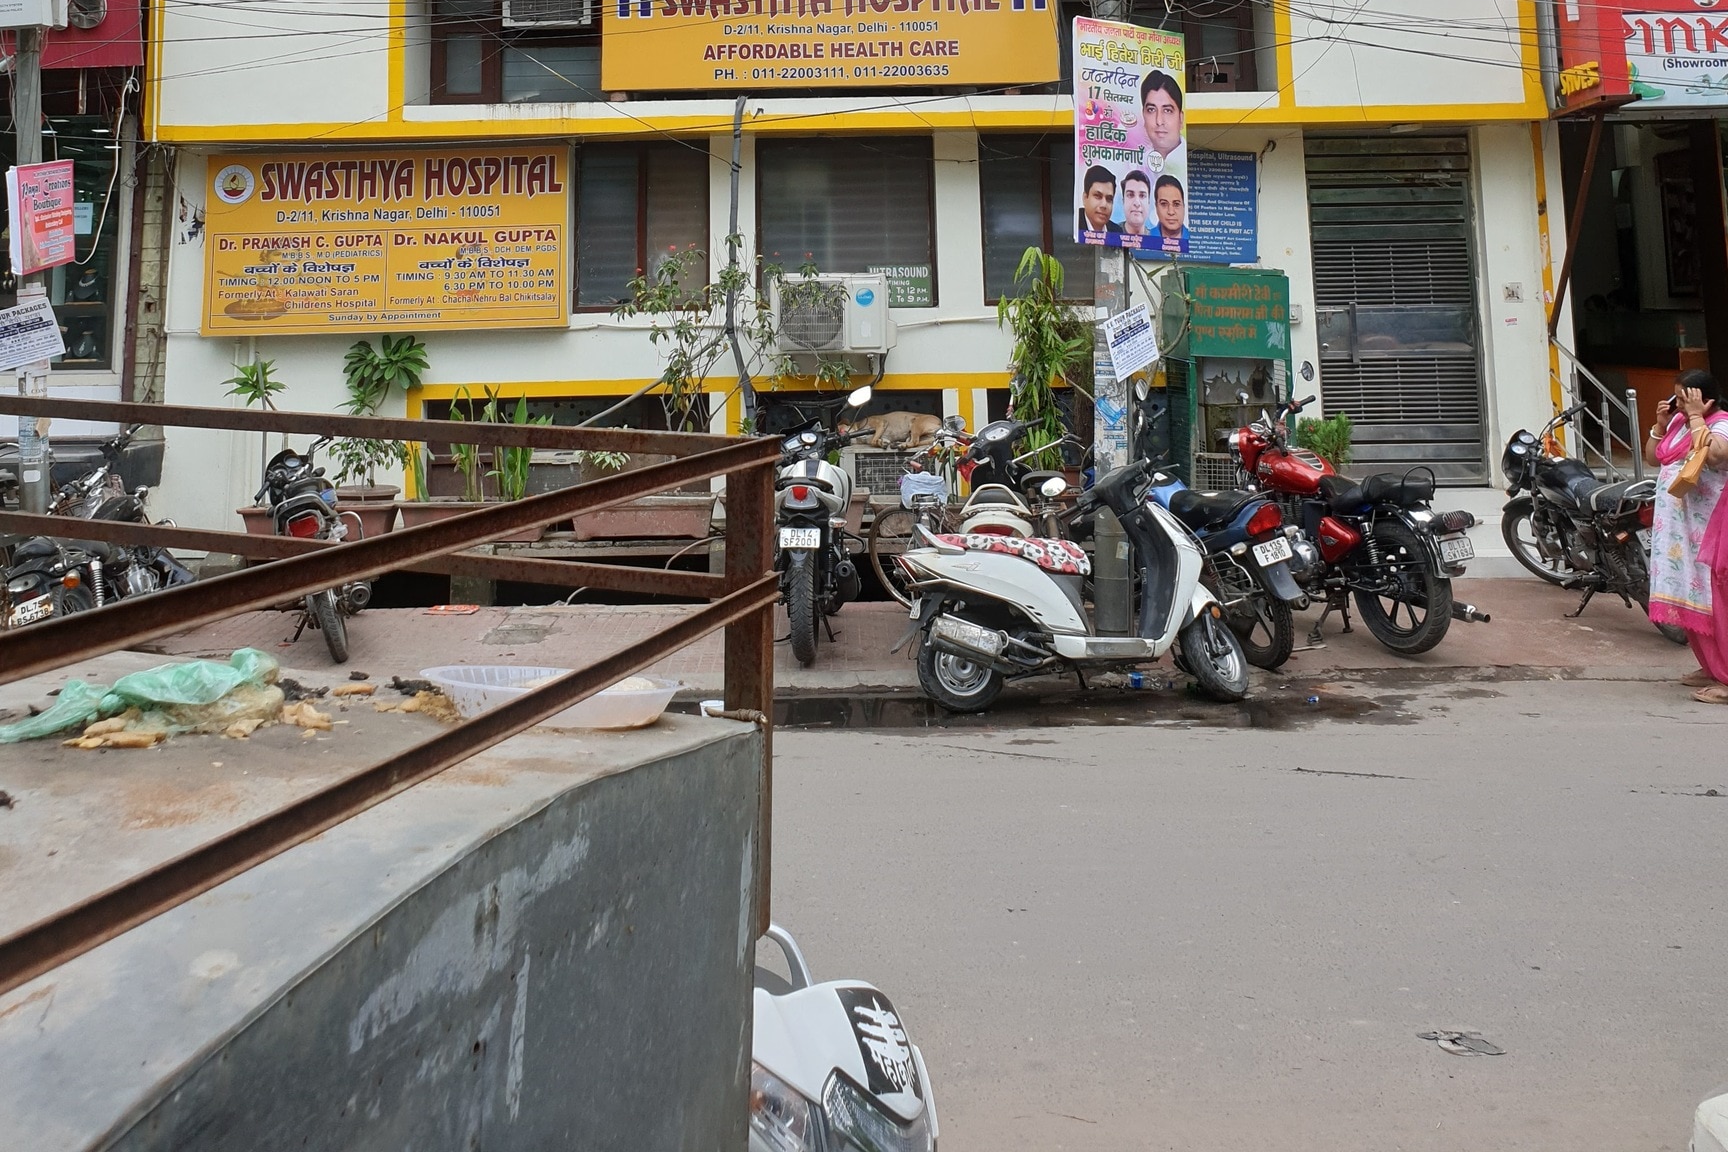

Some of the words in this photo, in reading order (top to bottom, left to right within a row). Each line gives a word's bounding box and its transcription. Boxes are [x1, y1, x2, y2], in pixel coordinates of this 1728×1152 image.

[724, 24, 763, 36] D-2/11,
[767, 24, 813, 35] Krishna
[816, 23, 854, 36] Nagar,
[858, 22, 888, 33] Delhi
[899, 21, 939, 32] 110051
[703, 43, 824, 61] AFFORDABLE
[830, 41, 903, 58] HEALTH
[909, 40, 960, 57] CARE
[1080, 39, 1104, 61] भाई
[1166, 51, 1183, 71] जी
[714, 69, 739, 80] PH.
[752, 65, 849, 80] 011-22003111,
[854, 64, 949, 78] 011-22003635
[1082, 67, 1140, 88] जन्मदिन
[1088, 86, 1101, 100] 17
[1103, 89, 1134, 104] सितम्बर
[1085, 122, 1127, 142] हार्दिक
[1218, 152, 1253, 161] Ultrasound
[260, 159, 415, 205] SWASTHYA
[424, 155, 563, 202] HOSPITAL
[277, 210, 318, 224] D-2/11,
[322, 209, 369, 222] Krishna
[373, 208, 413, 223] Nagar,
[416, 206, 448, 219] Delhi
[459, 205, 501, 218] 110051
[219, 239, 237, 251] Dr.
[242, 236, 311, 250] PRAKASH
[315, 236, 330, 248] C.
[334, 234, 383, 248] GUPTA
[393, 234, 417, 246] Dr.
[424, 231, 488, 245] NAKUL
[494, 229, 557, 243] GUPTA
[332, 250, 383, 259] (PEDIATRICS)
[244, 262, 280, 274] बच्चों
[283, 263, 297, 273] के
[303, 261, 355, 274] विशेषज्ञ
[419, 257, 455, 269] बच्चों
[457, 258, 471, 269] के
[478, 256, 530, 269] विशेषज्ञ
[218, 278, 257, 286] TIMING
[268, 277, 295, 286] 12.00
[300, 276, 332, 285] NOON
[336, 275, 351, 284] TO
[354, 275, 360, 283] 5
[363, 274, 380, 283] PM
[396, 272, 434, 281] TIMING
[444, 271, 466, 280] 9.30
[469, 270, 486, 279] AM
[490, 270, 504, 278] TO
[507, 269, 535, 278] 11.30
[537, 268, 555, 277] AM
[444, 282, 466, 291] 6.30
[469, 281, 486, 290] PM
[489, 281, 504, 289] TO
[507, 280, 535, 289] 10.00
[538, 279, 554, 288] PM
[218, 290, 262, 301] Formerly
[265, 290, 276, 298] At
[285, 288, 327, 298] Kalawati
[330, 288, 359, 296] Saran
[390, 296, 424, 306] Formerly
[426, 295, 436, 304] At
[442, 294, 472, 304] Chacha
[473, 293, 497, 303] Nehru
[499, 293, 511, 302] Bal
[514, 292, 556, 302] Chikitsalay
[907, 295, 915, 303] 9
[12, 303, 47, 317] PACKAGES
[283, 300, 332, 310] Childrens
[335, 298, 376, 310] Hospital
[328, 314, 364, 323] Sunday
[366, 313, 377, 322] by
[380, 311, 441, 322] Appointment
[784, 538, 817, 546] SF2001
